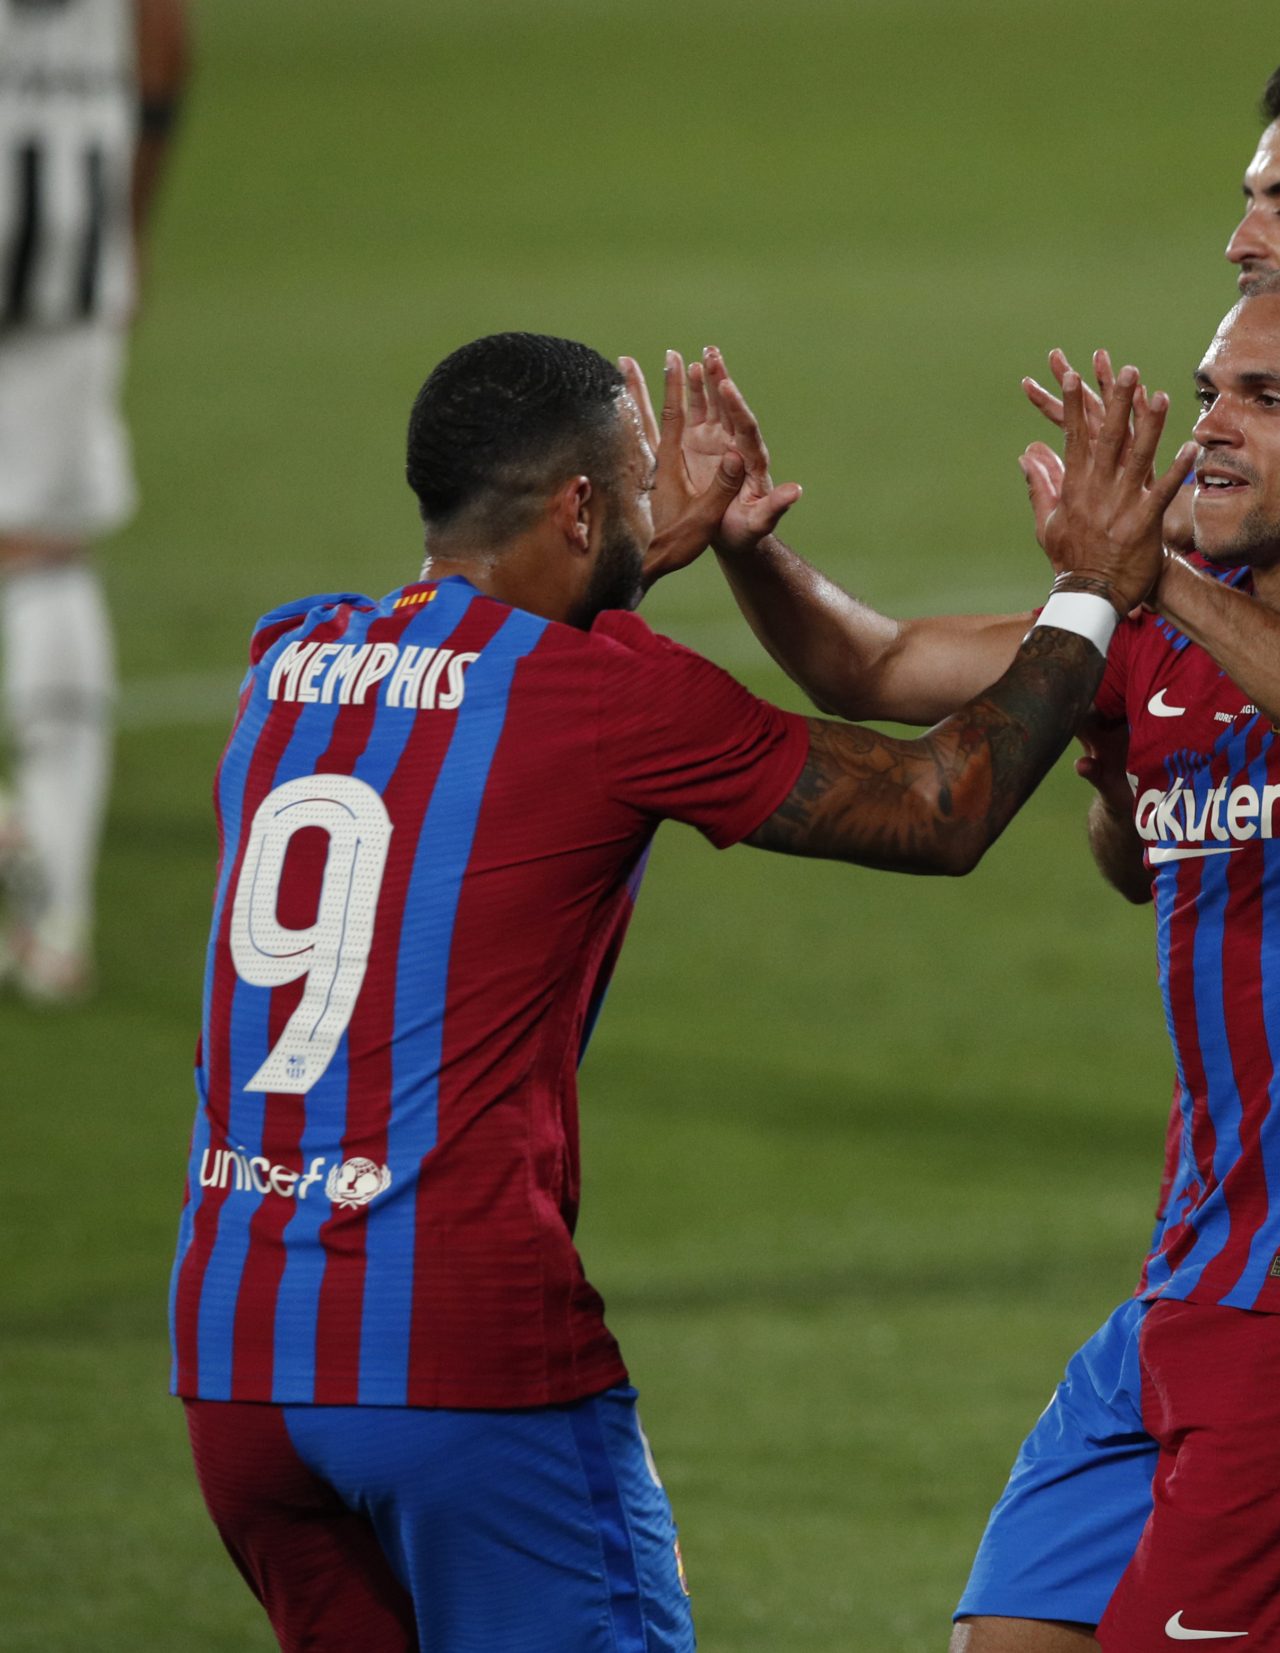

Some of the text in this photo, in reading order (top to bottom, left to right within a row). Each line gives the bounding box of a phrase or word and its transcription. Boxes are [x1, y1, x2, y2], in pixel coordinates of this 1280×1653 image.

[267, 641, 481, 710] MEMPHIS
[229, 773, 394, 1094] 9
[199, 1146, 326, 1200] unicef
